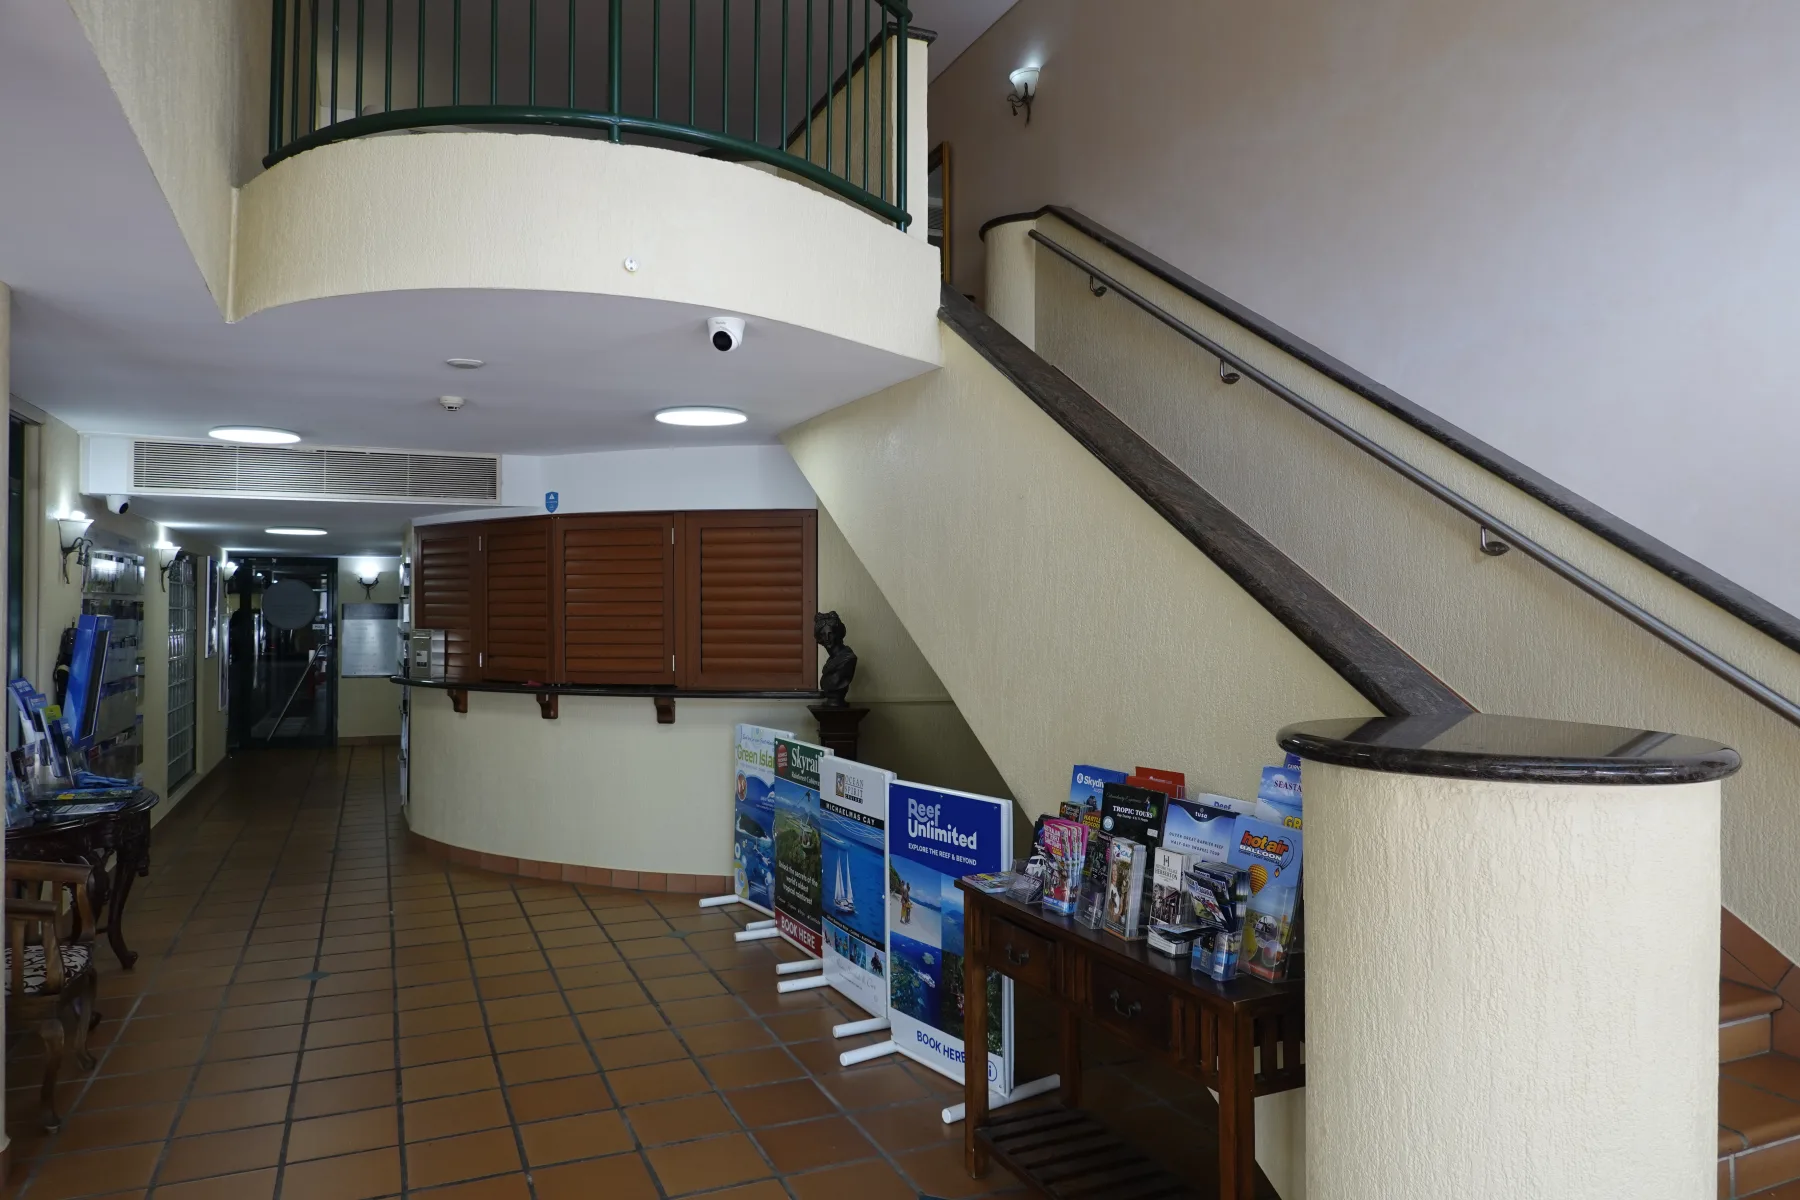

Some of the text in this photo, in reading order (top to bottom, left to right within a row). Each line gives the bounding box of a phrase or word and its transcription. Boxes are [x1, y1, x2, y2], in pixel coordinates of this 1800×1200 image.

[737, 744, 757, 764] Green
[760, 749, 774, 769] Isla
[791, 745, 820, 774] Skyrail
[845, 775, 863, 787] OCEAN
[845, 785, 863, 797] SPIRIT
[1274, 780, 1302, 792] SEASTA
[825, 802, 875, 826] MICHAELMAS CAY
[908, 798, 941, 827] Reef
[1112, 805, 1153, 819] TROPIC TOURS
[1195, 811, 1208, 819] tusa
[908, 818, 977, 850] Unlimited
[1196, 838, 1213, 847] BARRIER
[1240, 830, 1289, 856] hot air
[908, 843, 929, 854] EXPLORE
[929, 847, 938, 857] THE
[939, 851, 951, 859] REEF
[956, 855, 977, 866] BEYOND
[1239, 844, 1282, 861] BALLOON
[782, 916, 816, 949] BOOK HERE
[916, 1030, 941, 1054] BOOK
